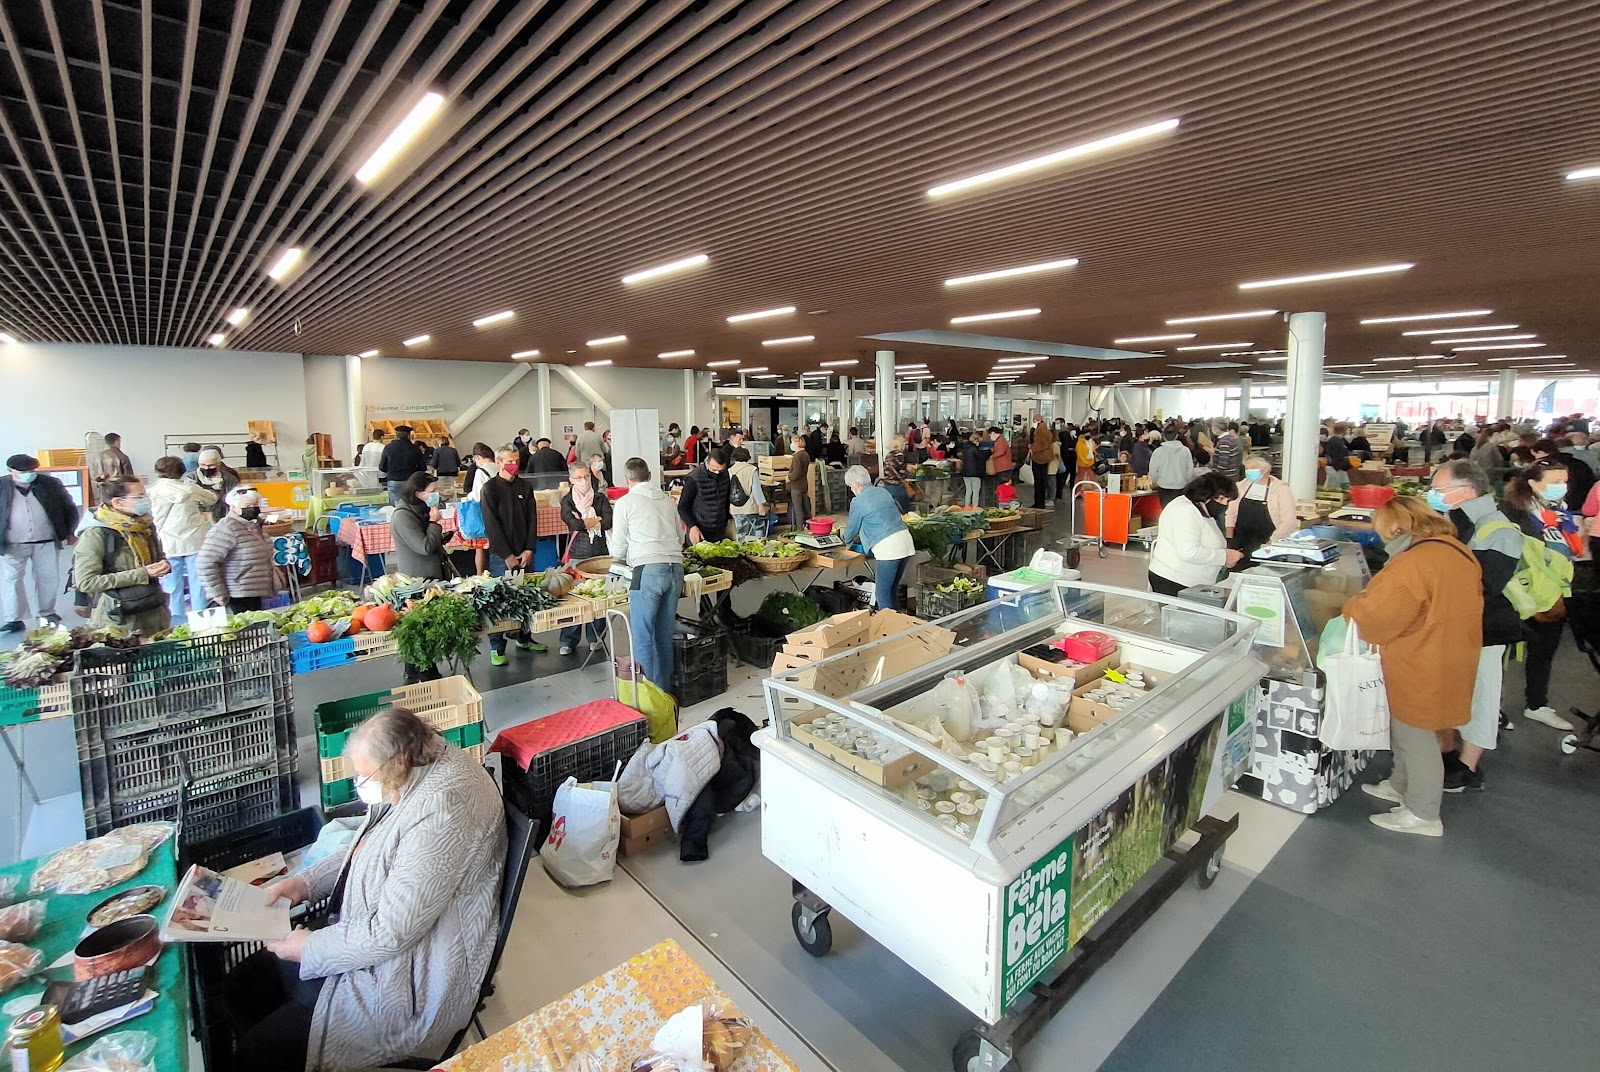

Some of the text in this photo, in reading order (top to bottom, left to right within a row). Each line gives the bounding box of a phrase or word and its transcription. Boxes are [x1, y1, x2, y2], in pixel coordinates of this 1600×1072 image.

[1008, 851, 1067, 917] Ferme
[1021, 867, 1031, 885] La
[1007, 887, 1066, 967] Béla
[1025, 902, 1035, 917] le
[1006, 925, 1065, 989] LA FERME AUX VACHES
[1006, 935, 1065, 1001] QUI FONT DU BON LAIT
